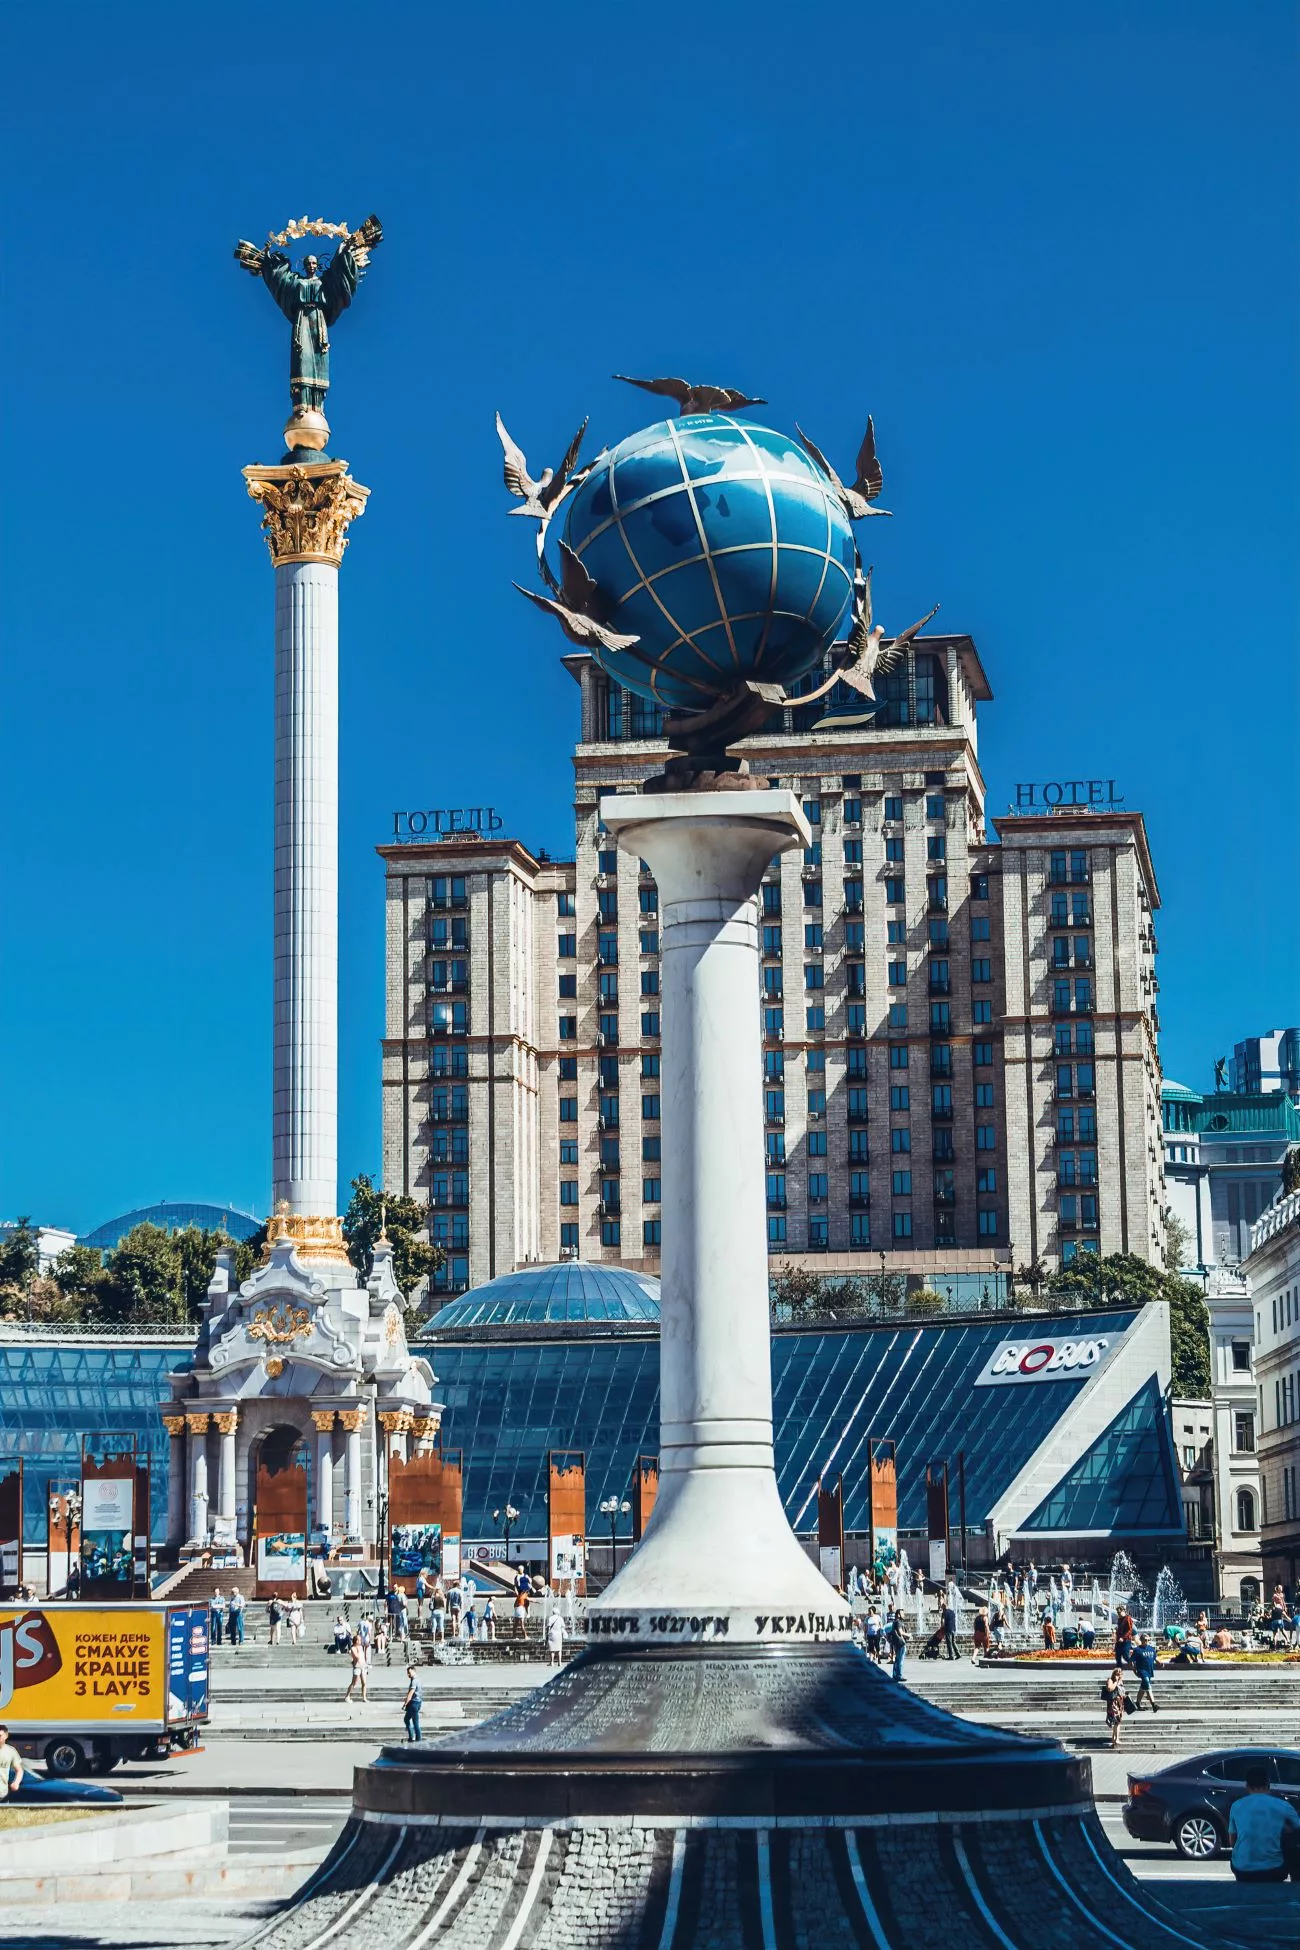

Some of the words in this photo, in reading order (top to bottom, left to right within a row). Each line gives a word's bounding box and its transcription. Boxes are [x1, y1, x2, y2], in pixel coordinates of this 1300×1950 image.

[1014, 779, 1125, 807] HOTEL
[391, 807, 503, 835] ГОТЕЛЬ
[990, 1338, 1109, 1376] GLOBUS
[467, 1545, 507, 1560] GLOBUS
[754, 1611, 835, 1635] УКРАЇНА
[75, 1634, 117, 1643] КОЖЕН
[119, 1634, 151, 1644] ДЕНЬ
[75, 1645, 150, 1659] СМАКУЄ
[74, 1661, 150, 1679] КРАЩЕ
[93, 1680, 151, 1696] LAY'S
